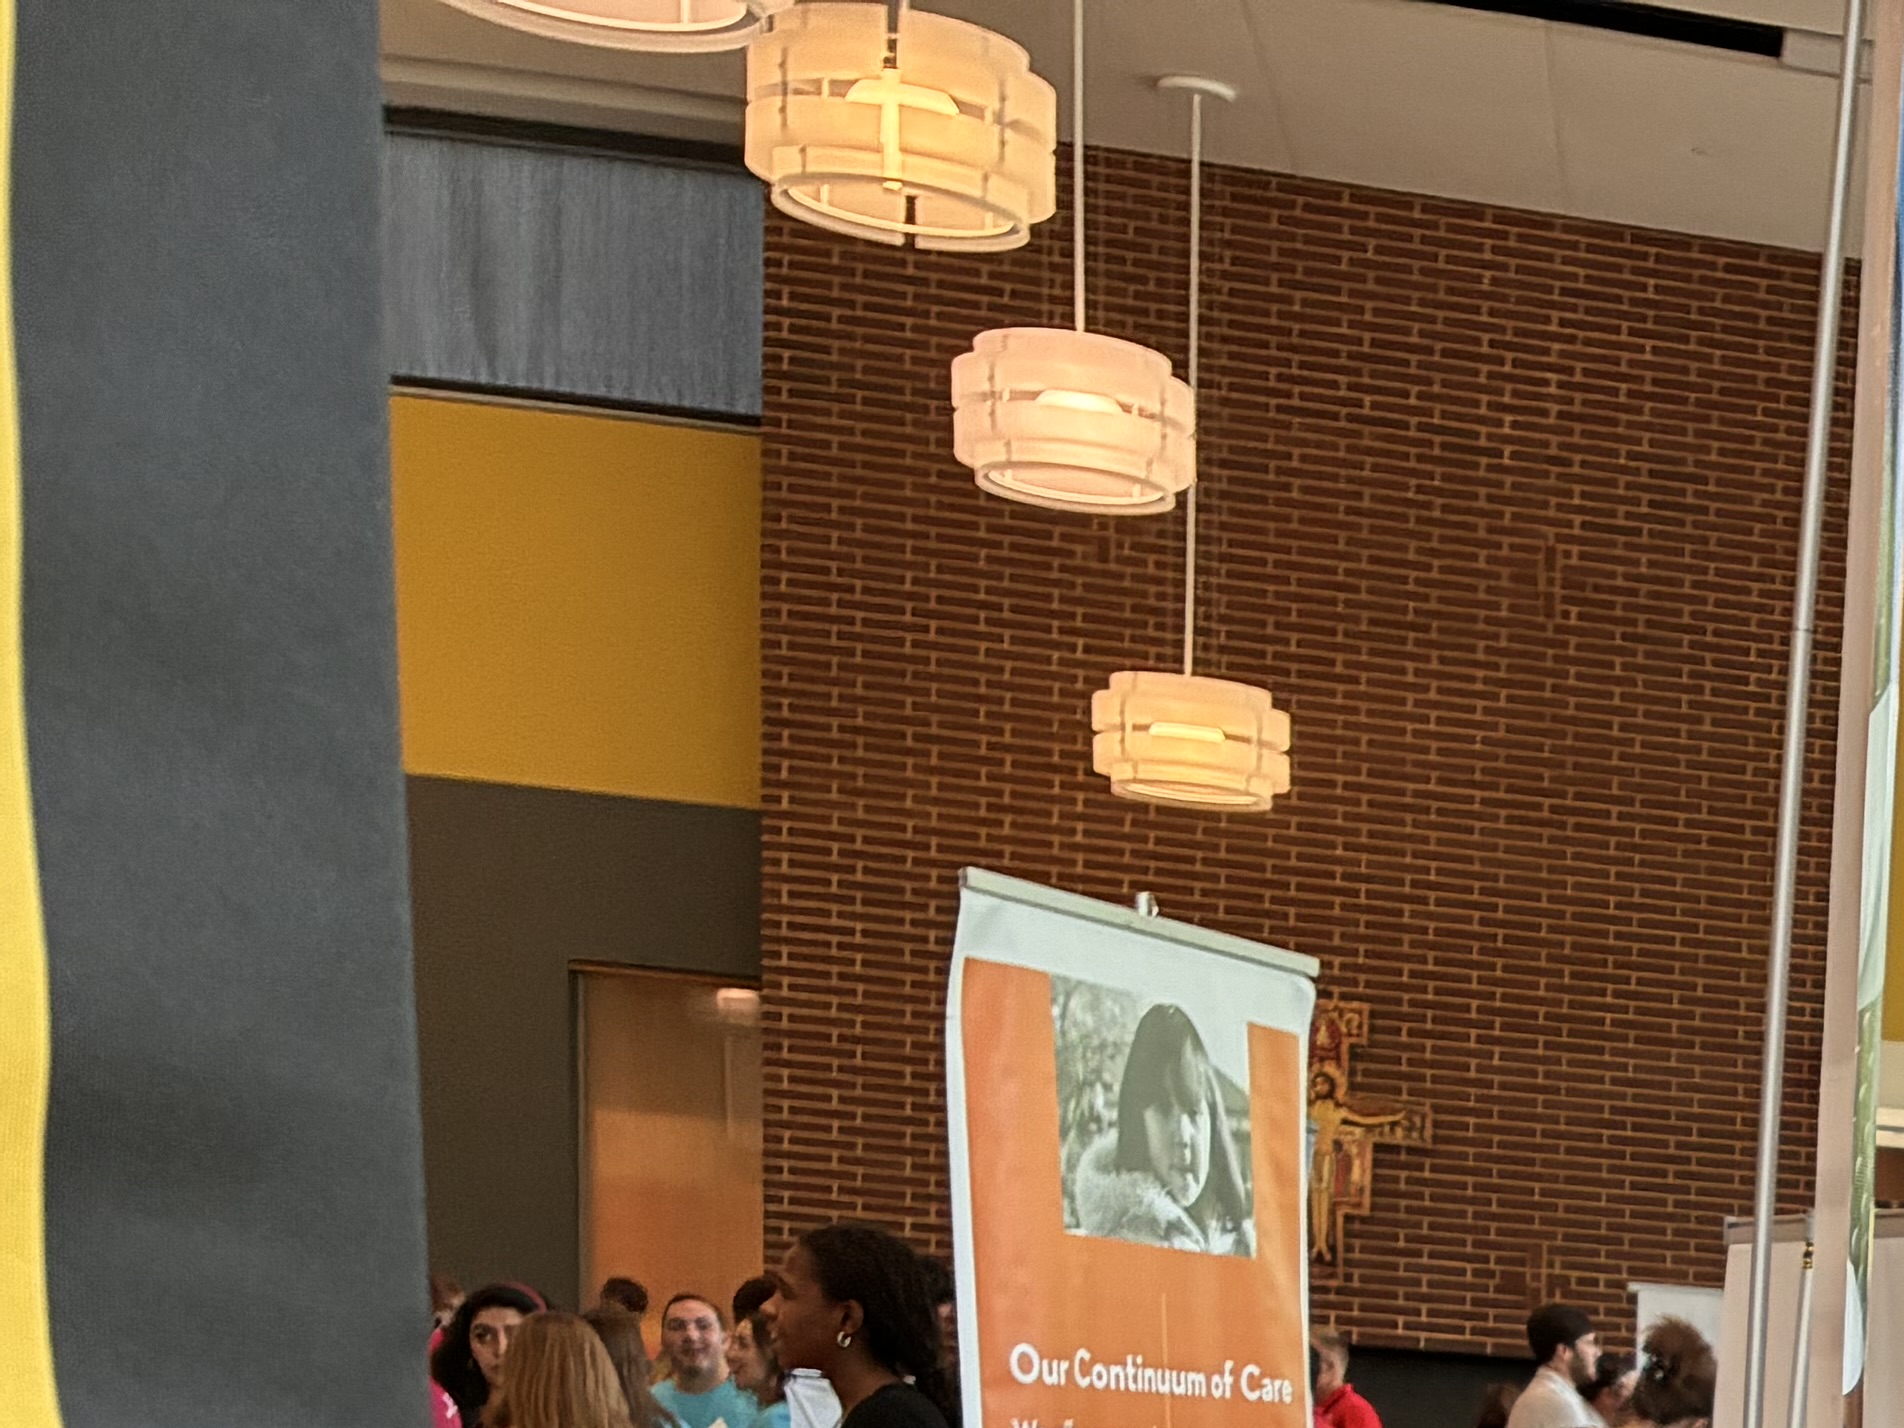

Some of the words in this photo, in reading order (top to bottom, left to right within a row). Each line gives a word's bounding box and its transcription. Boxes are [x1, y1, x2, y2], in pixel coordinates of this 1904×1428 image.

[1010, 1343, 1069, 1386] Our
[1074, 1348, 1206, 1398] Continuum
[1211, 1360, 1234, 1399] of
[1241, 1365, 1292, 1404] Care
